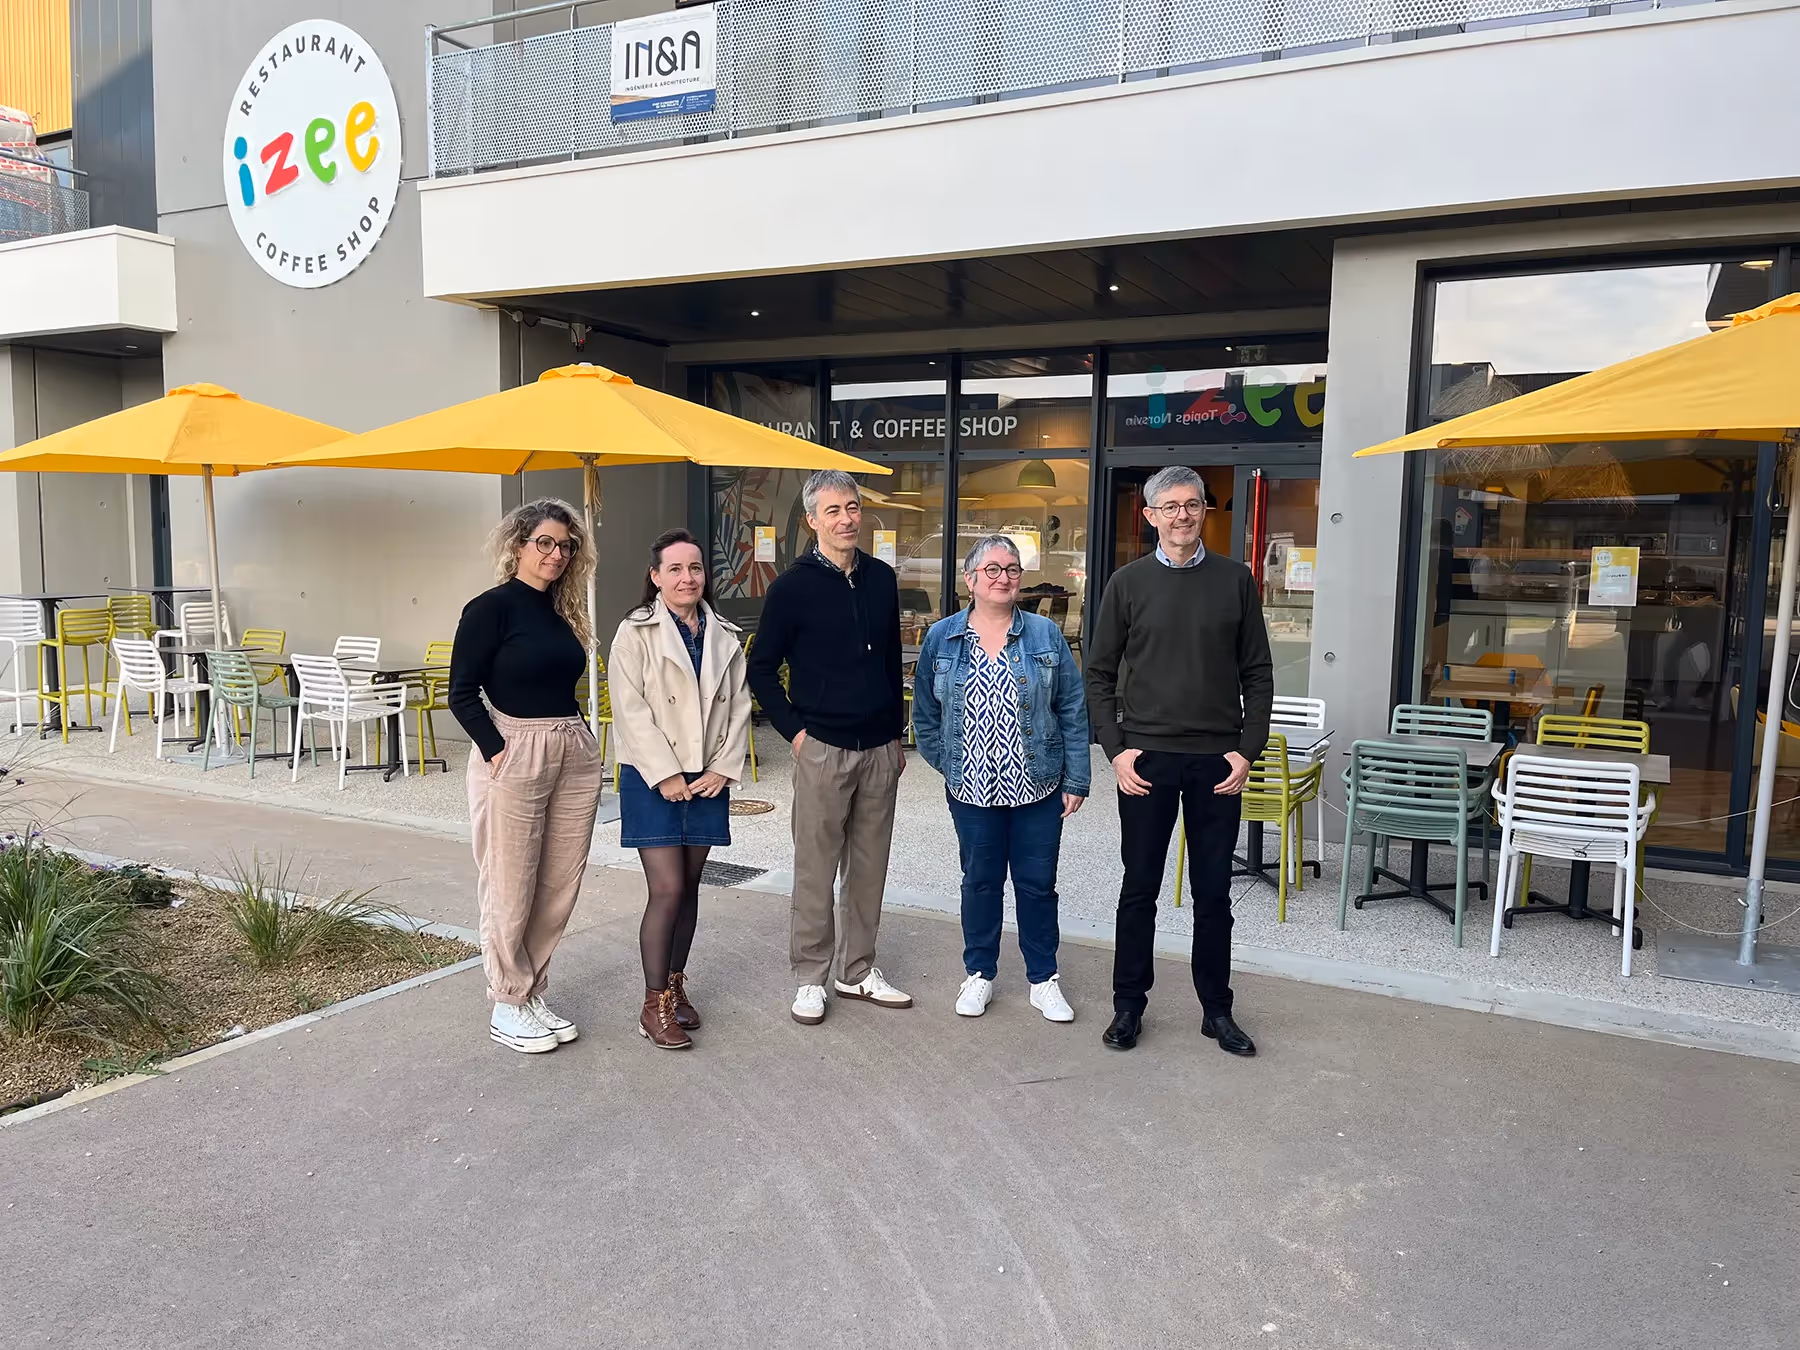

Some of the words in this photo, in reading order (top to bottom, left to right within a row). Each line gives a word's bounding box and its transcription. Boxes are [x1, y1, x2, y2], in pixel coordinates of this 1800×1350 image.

[239, 34, 367, 116] RESTAURANT
[625, 31, 700, 80] IN&A
[660, 77, 700, 87] ARCHITECTURE
[234, 101, 380, 207] izee
[255, 231, 328, 274] COFFEE
[336, 195, 382, 262] SHOP
[849, 420, 864, 439] &
[872, 417, 946, 439] COFFEE
[960, 415, 1018, 437] SHOP
